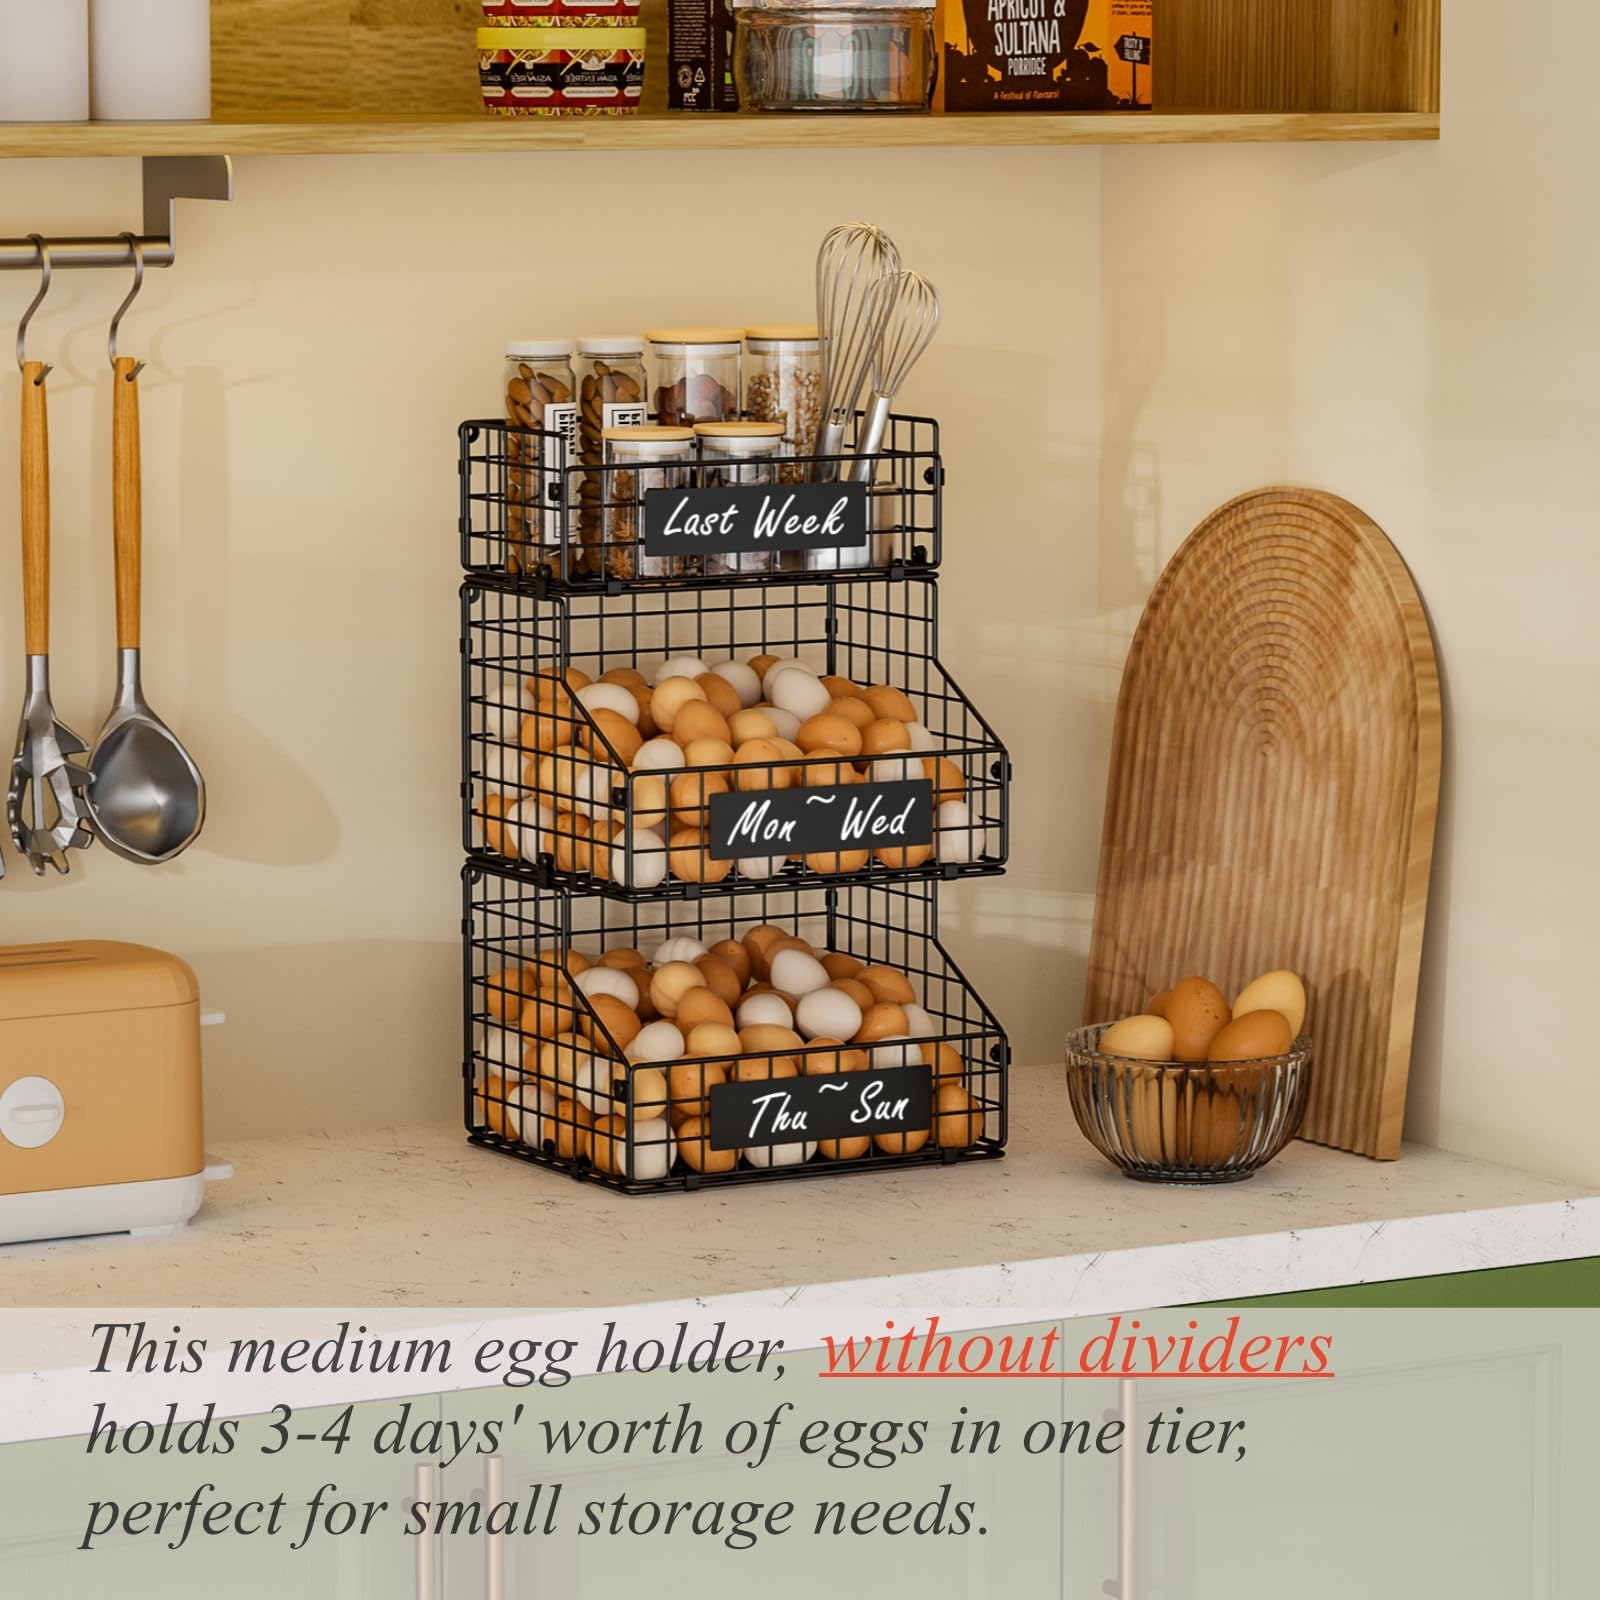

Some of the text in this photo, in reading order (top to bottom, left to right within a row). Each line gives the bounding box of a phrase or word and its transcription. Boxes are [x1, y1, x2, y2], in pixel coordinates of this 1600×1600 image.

[994, 19, 1061, 56] SULTANA
[1008, 57, 1047, 76] PORRIDGE
[663, 494, 849, 539] Last Week
[727, 799, 797, 846] Mon
[840, 794, 916, 841] Wed
[748, 1091, 808, 1138] Thu
[850, 1080, 909, 1123] Sun
